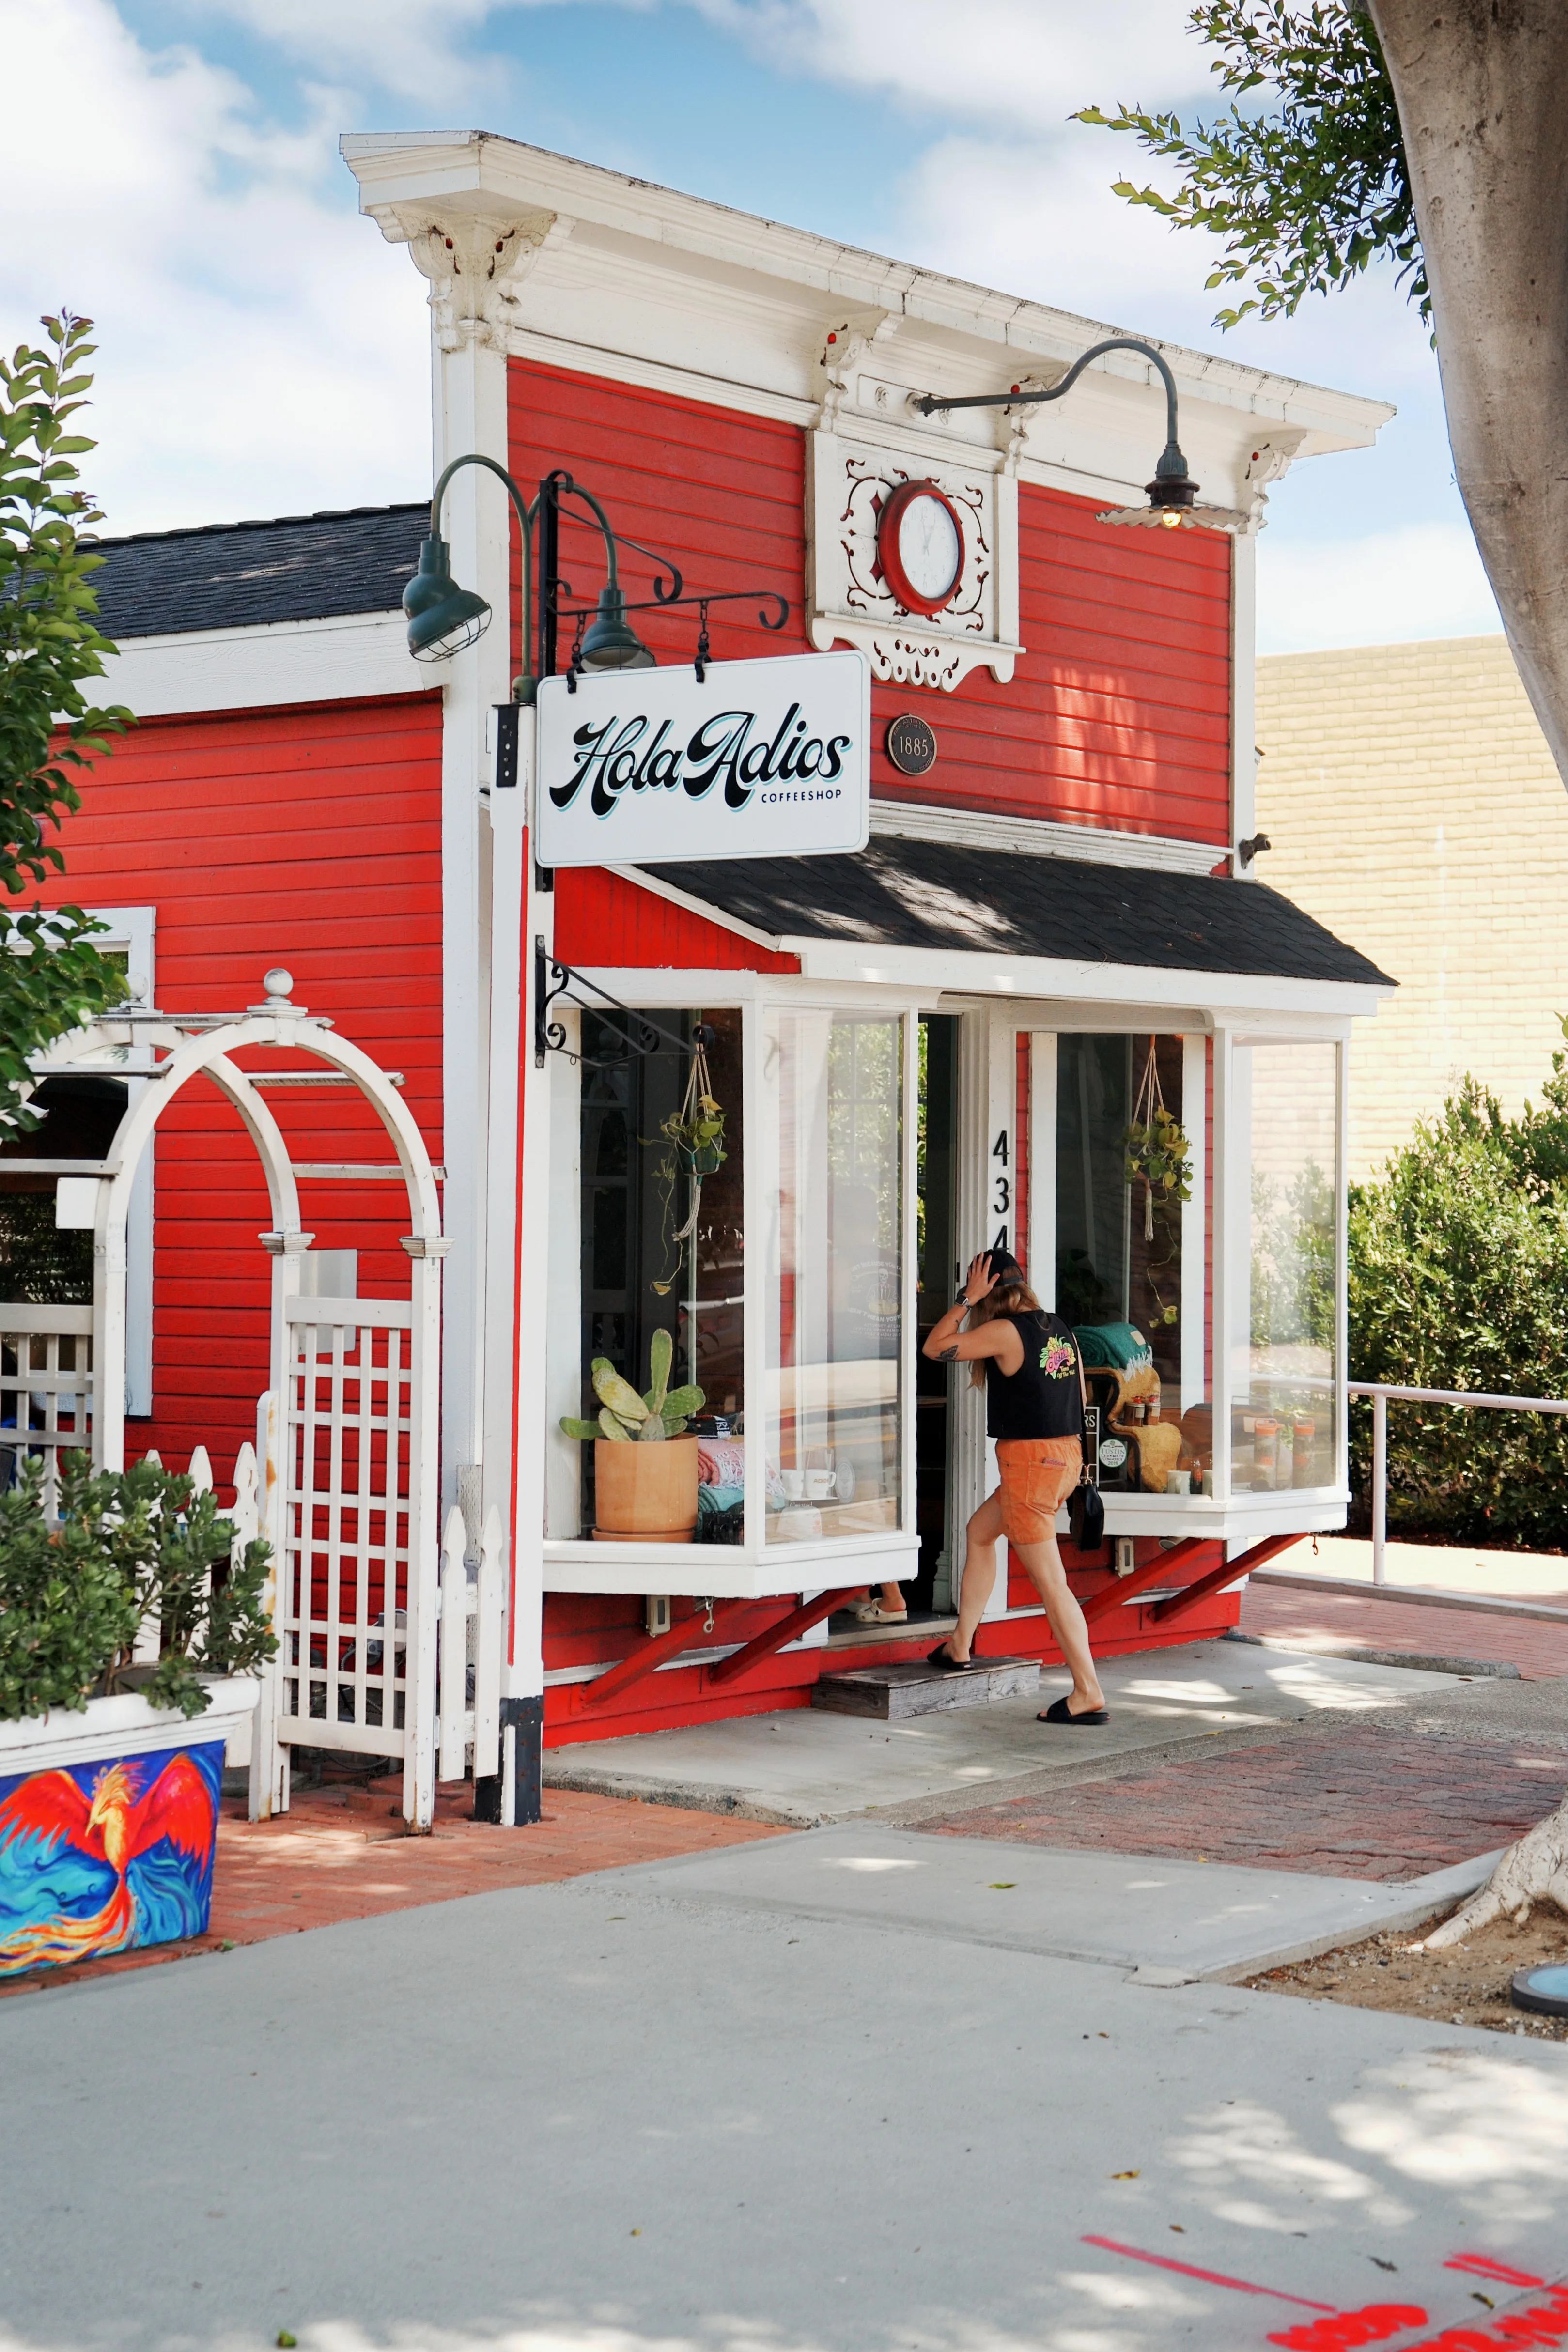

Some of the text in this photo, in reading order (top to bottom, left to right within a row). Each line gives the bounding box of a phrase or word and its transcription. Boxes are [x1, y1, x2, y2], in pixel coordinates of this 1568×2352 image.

[900, 736, 928, 757] 1885
[549, 702, 853, 820] Hola Adios
[761, 789, 842, 803] COFFEESHOP
